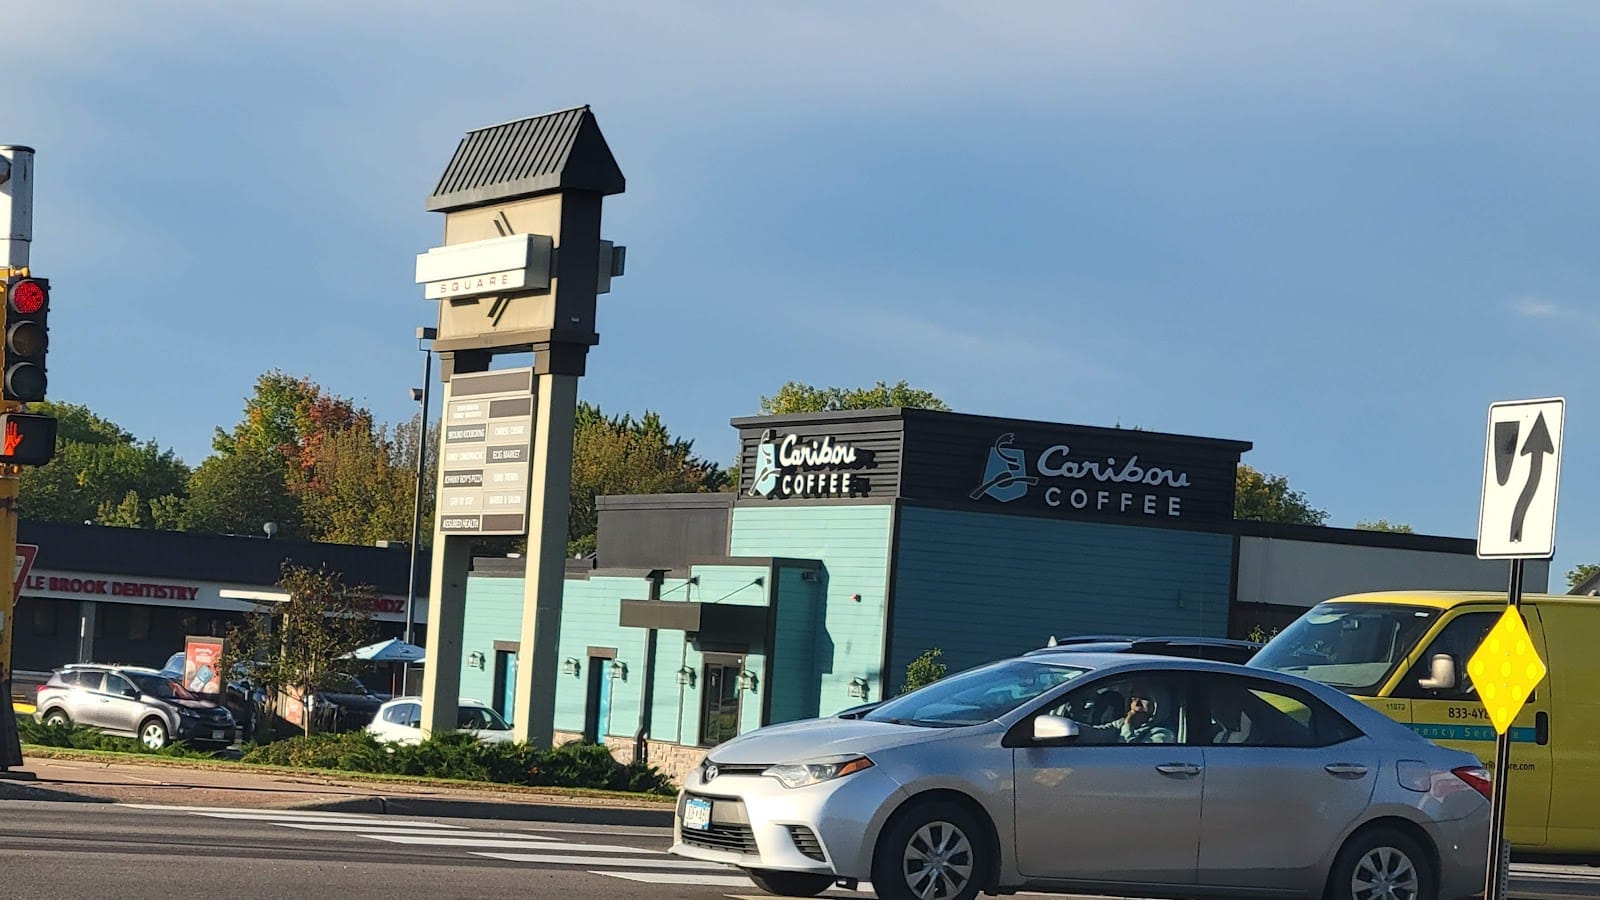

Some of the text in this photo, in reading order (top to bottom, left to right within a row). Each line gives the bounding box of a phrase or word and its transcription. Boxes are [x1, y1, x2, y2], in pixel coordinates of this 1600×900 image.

[440, 274, 508, 293] SQUARE
[503, 449, 520, 459] MARKET
[780, 434, 856, 467] Caribou
[1037, 445, 1191, 487] Caribou
[782, 473, 850, 494] COFFEE
[1045, 487, 1181, 516] COFFEE
[442, 519, 479, 529] ASSURED HEALTH
[26, 575, 199, 600] LE BROOK DENTISTRY
